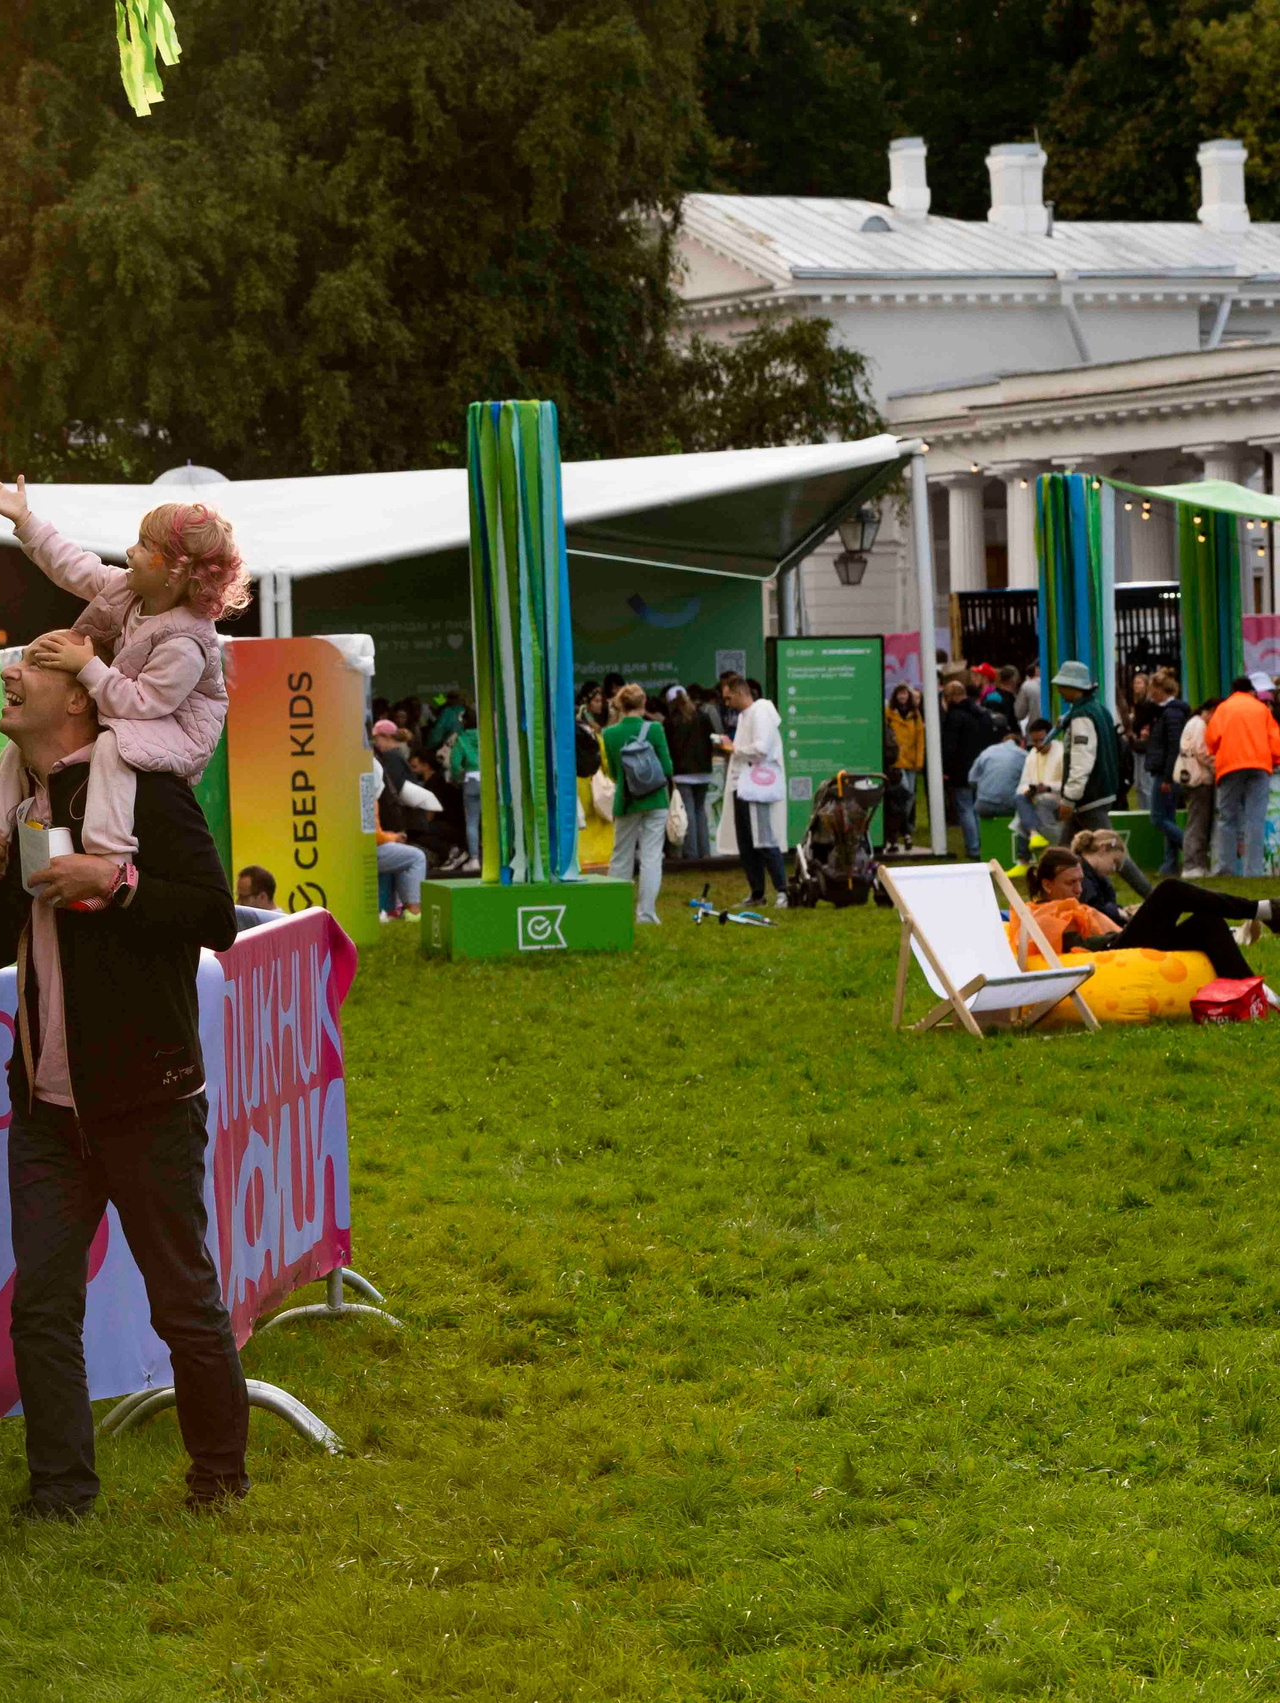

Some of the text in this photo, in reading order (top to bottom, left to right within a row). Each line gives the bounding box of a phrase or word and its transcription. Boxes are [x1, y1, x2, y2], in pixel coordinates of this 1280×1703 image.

[623, 662, 648, 674] для
[287, 670, 319, 869] СБЕР KIDS
[220, 943, 344, 1131] ПИКНИК
